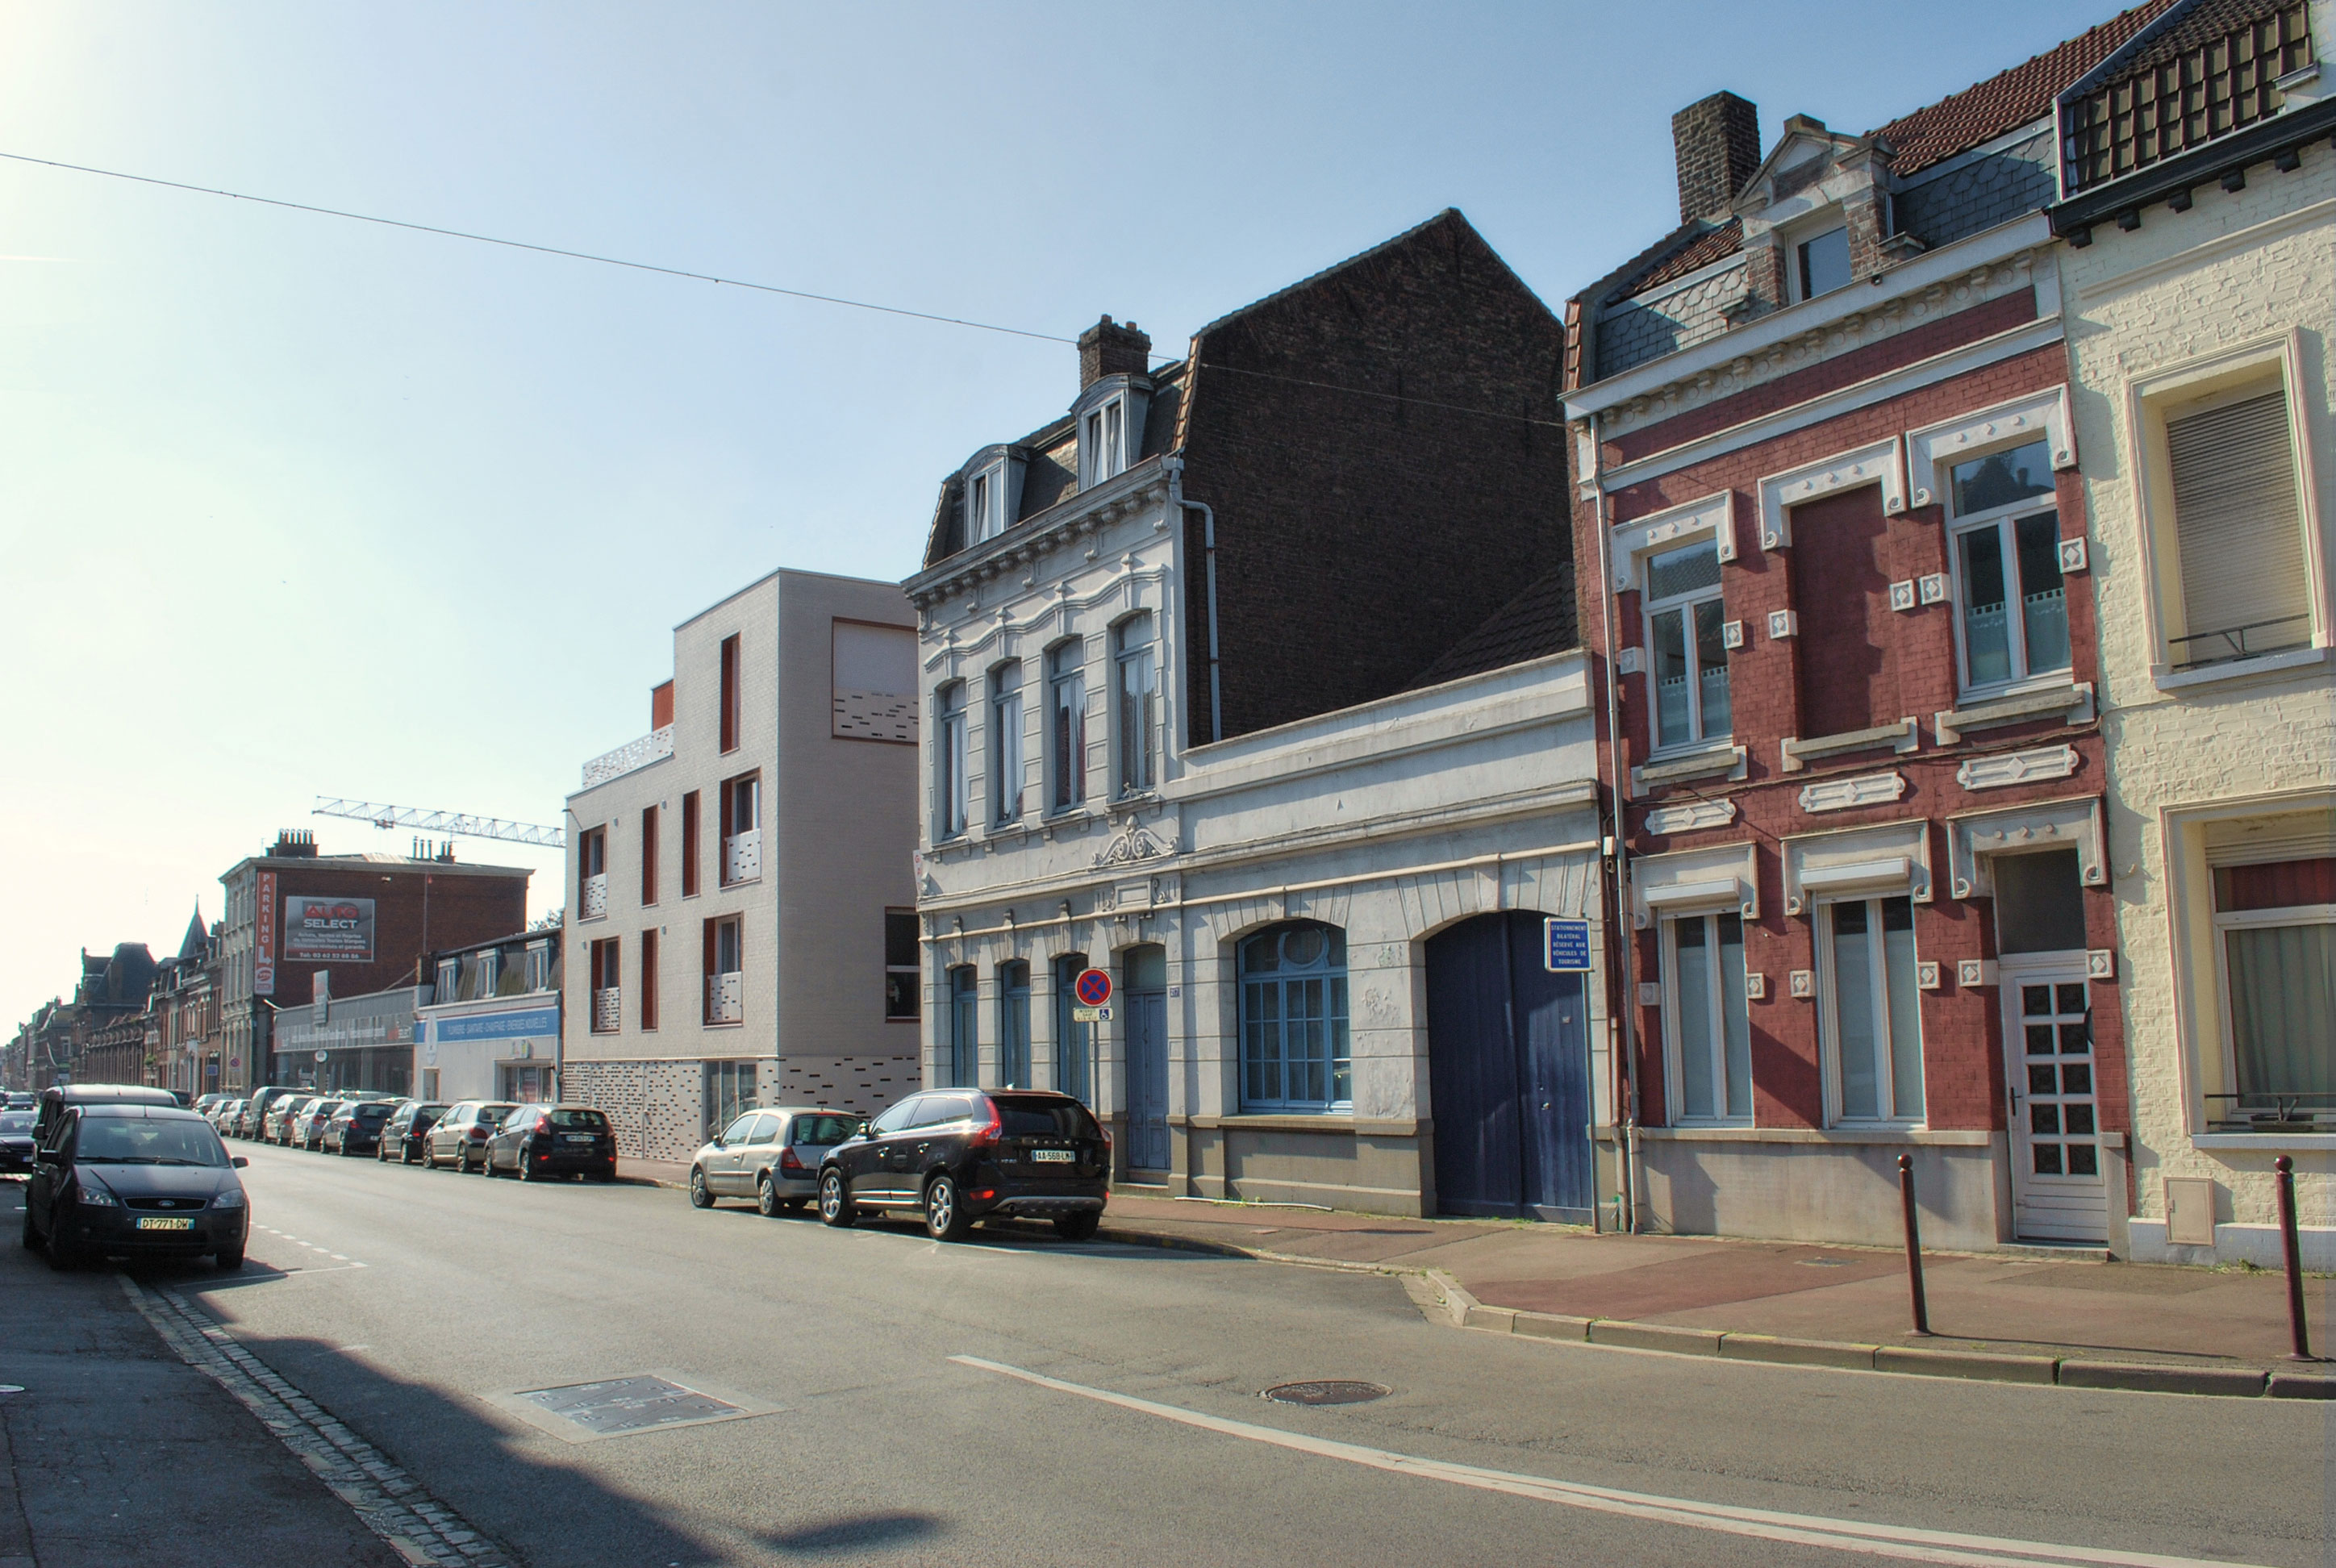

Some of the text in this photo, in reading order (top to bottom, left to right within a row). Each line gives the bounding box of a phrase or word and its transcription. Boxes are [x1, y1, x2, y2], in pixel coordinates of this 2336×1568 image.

[261, 874, 270, 943] PARKING
[304, 905, 358, 919] AUTO
[303, 919, 357, 929] SELECT
